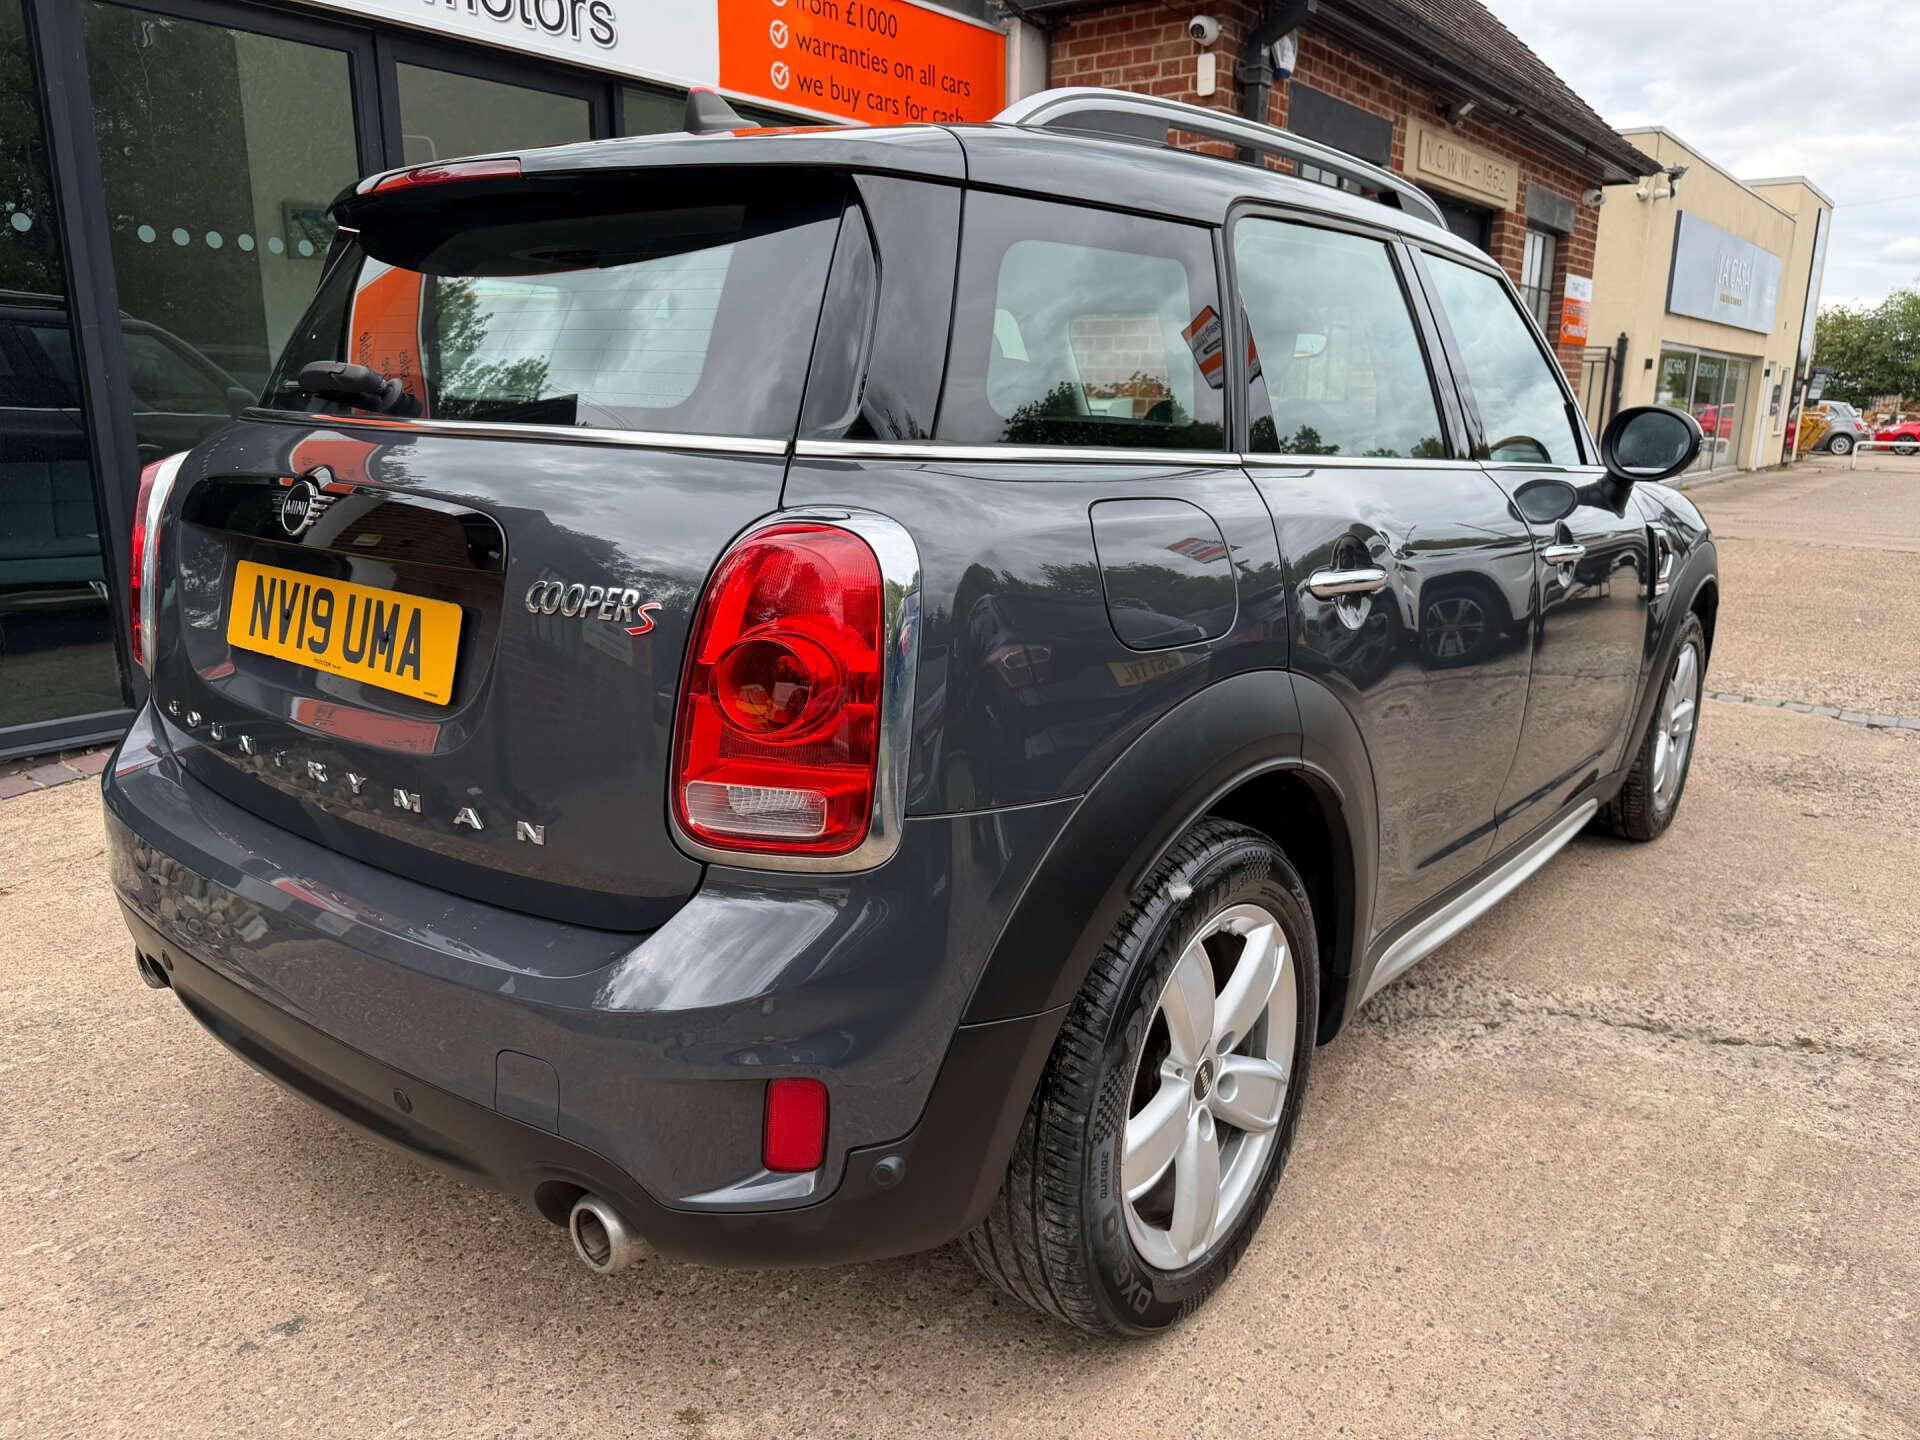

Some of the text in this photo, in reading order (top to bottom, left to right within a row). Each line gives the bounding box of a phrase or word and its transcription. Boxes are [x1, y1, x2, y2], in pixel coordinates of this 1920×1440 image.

[428, 0, 616, 46] ors
[846, 1, 898, 39] £1000
[796, 32, 971, 97] warranties on all cars
[797, 73, 824, 97] we
[831, 76, 860, 113] buy
[867, 92, 900, 116] cars
[905, 95, 928, 121] for
[285, 499, 308, 515] MINI
[249, 574, 422, 682] NV19 UMA
[525, 580, 662, 636] COOPER S
[168, 699, 546, 847] COUNTRYMAN
